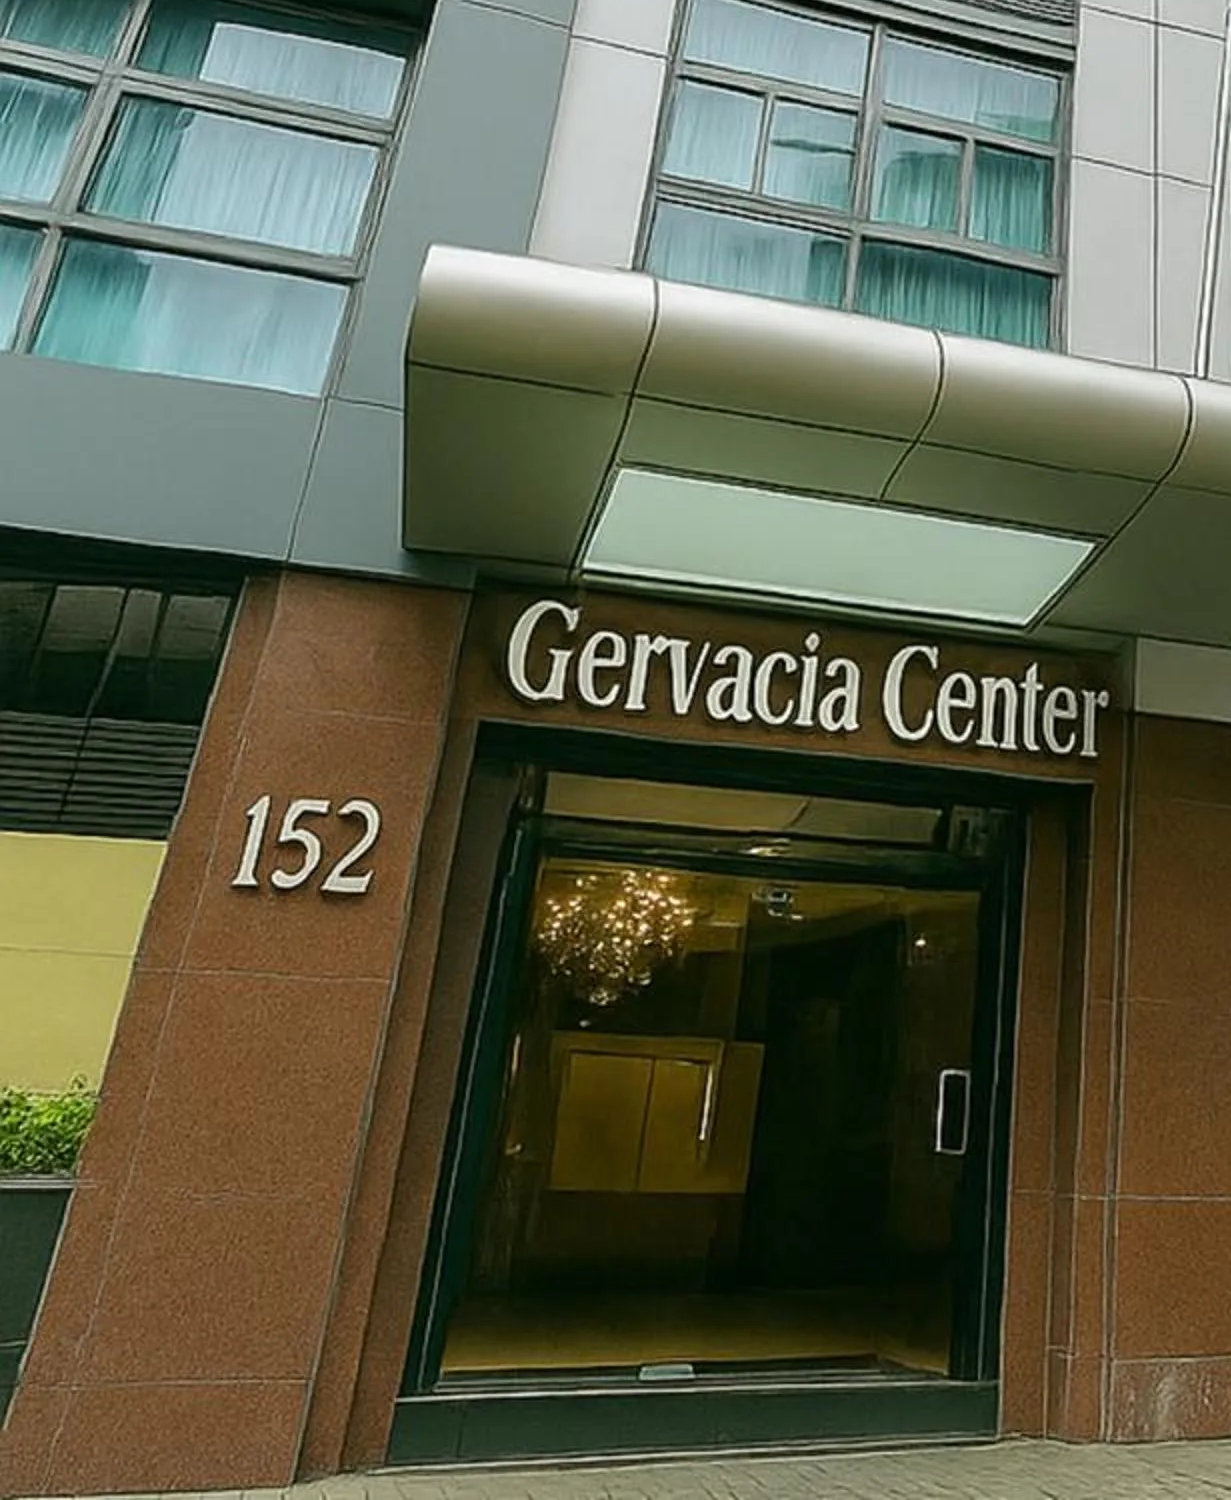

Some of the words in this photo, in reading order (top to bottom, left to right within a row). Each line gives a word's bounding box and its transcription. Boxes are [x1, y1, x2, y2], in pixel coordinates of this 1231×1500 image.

[507, 600, 860, 733] Gervacia
[883, 644, 1109, 757] Center
[232, 795, 381, 893] 152
